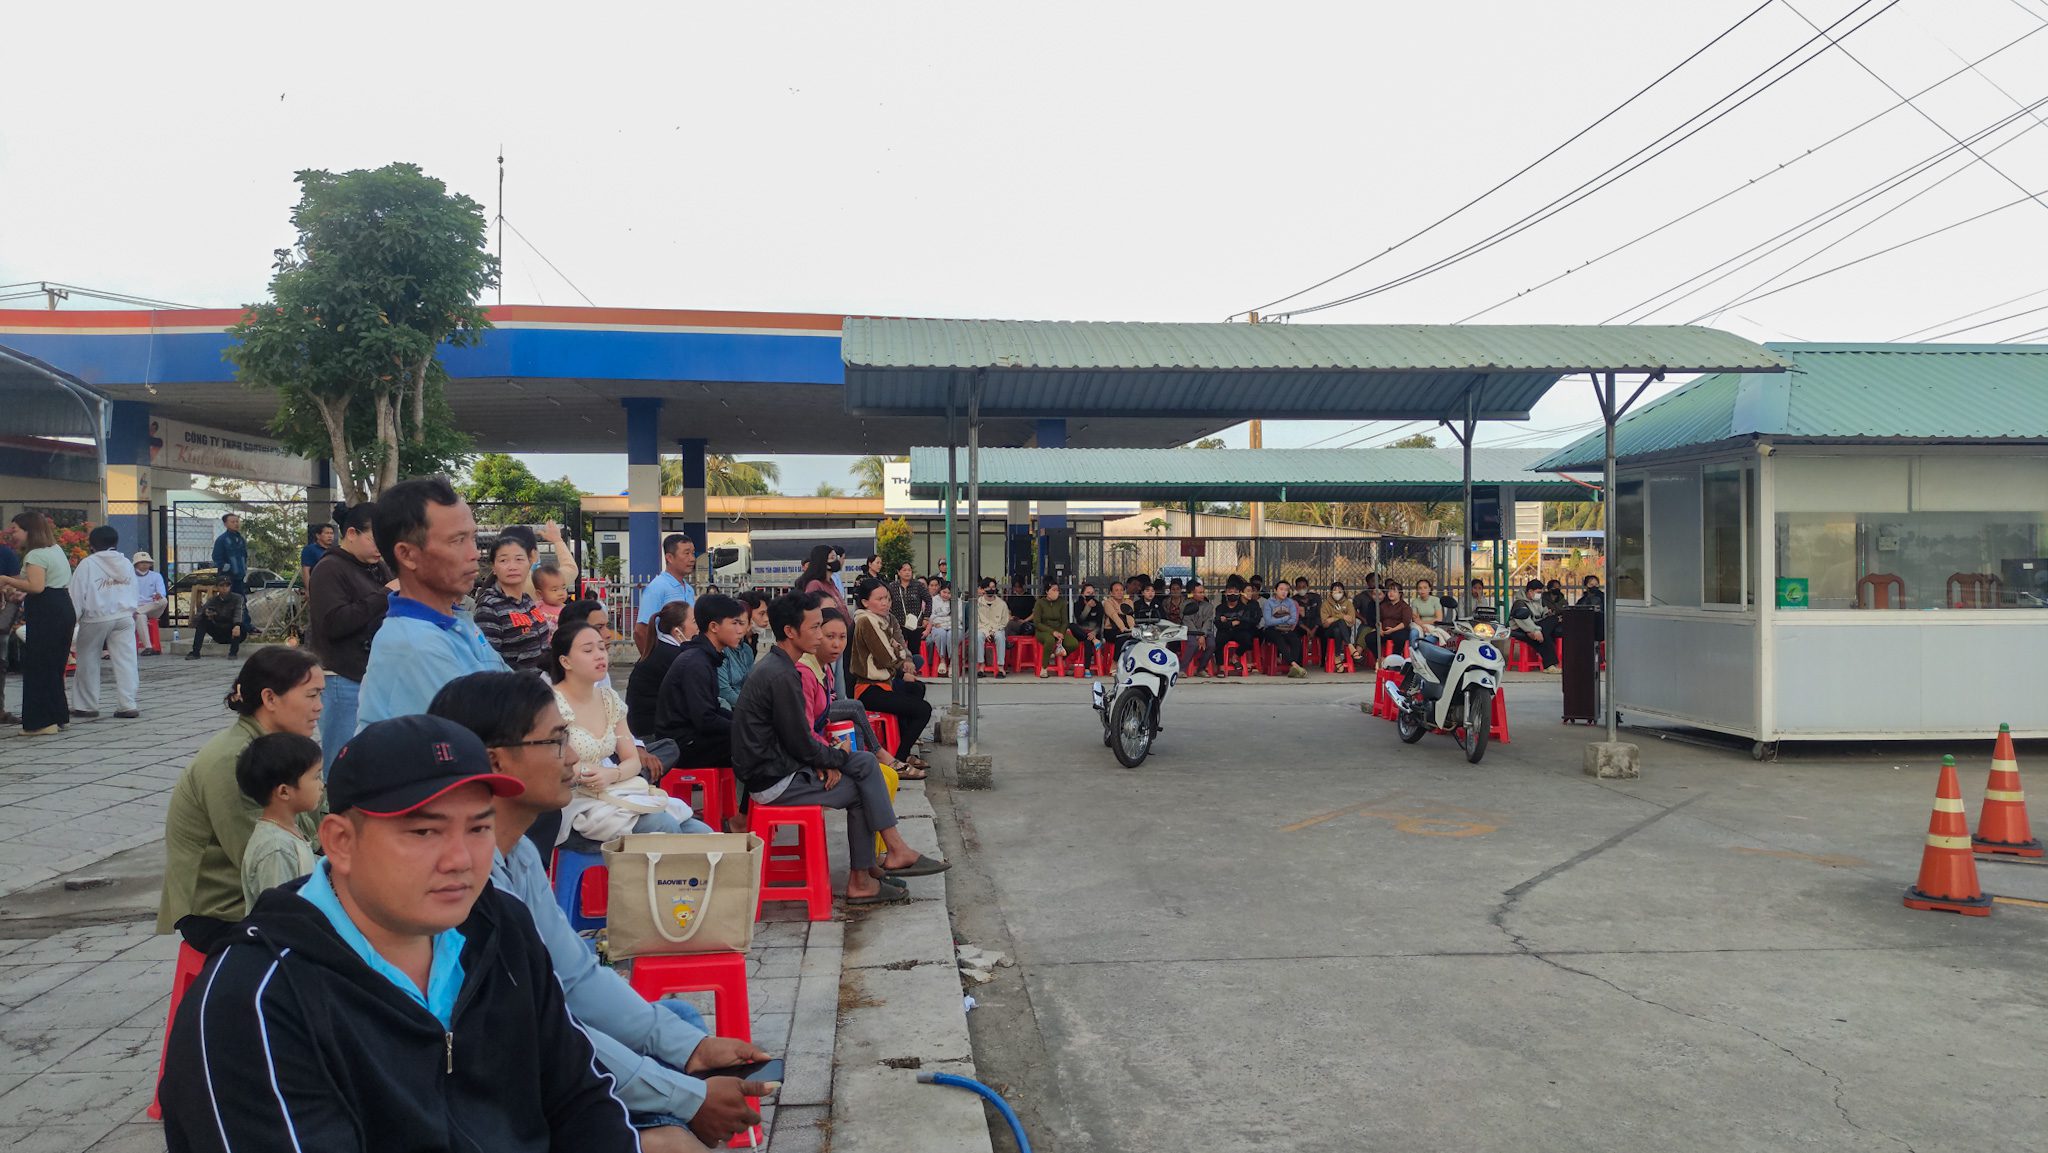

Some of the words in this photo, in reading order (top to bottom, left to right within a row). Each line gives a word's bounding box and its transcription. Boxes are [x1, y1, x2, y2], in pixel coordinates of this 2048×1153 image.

[210, 436, 219, 446] TY
[1152, 652, 1162, 663] 4
[1485, 648, 1492, 658] 1
